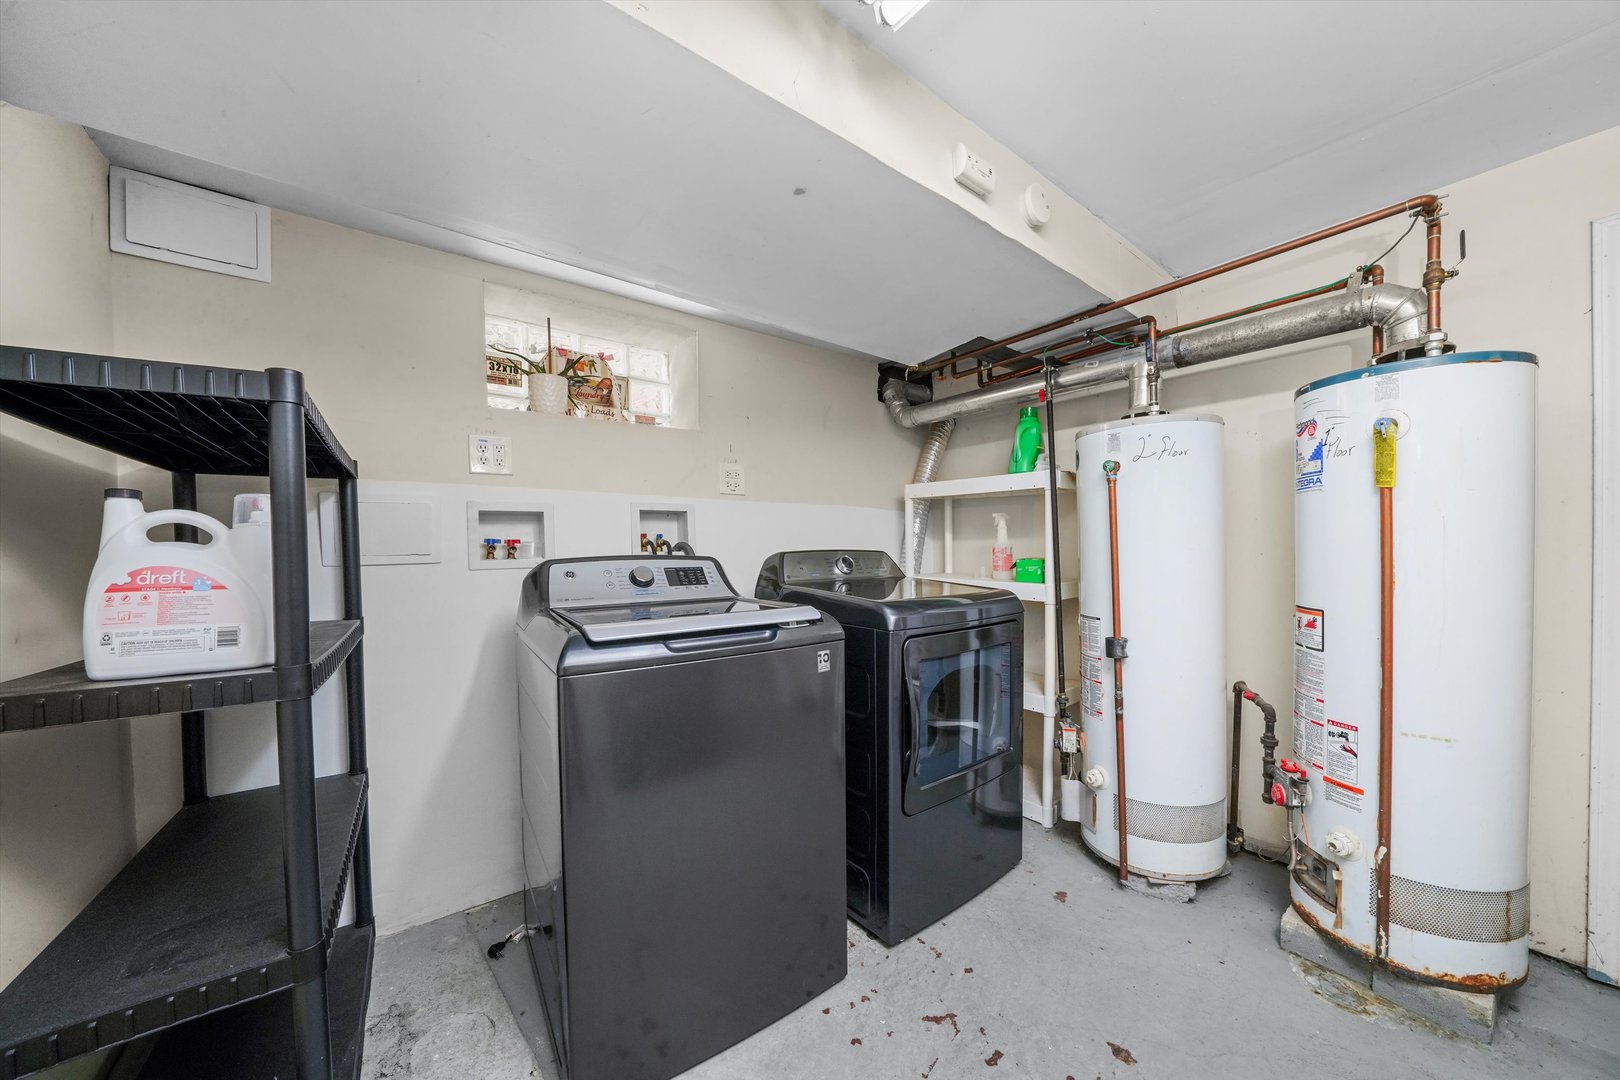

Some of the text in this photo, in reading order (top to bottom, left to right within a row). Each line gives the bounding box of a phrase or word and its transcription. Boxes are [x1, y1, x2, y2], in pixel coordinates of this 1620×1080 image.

[574, 387, 605, 402] Laundry
[591, 405, 615, 418] Loads
[136, 569, 187, 585] dreft
[1333, 720, 1357, 732] DANGER
